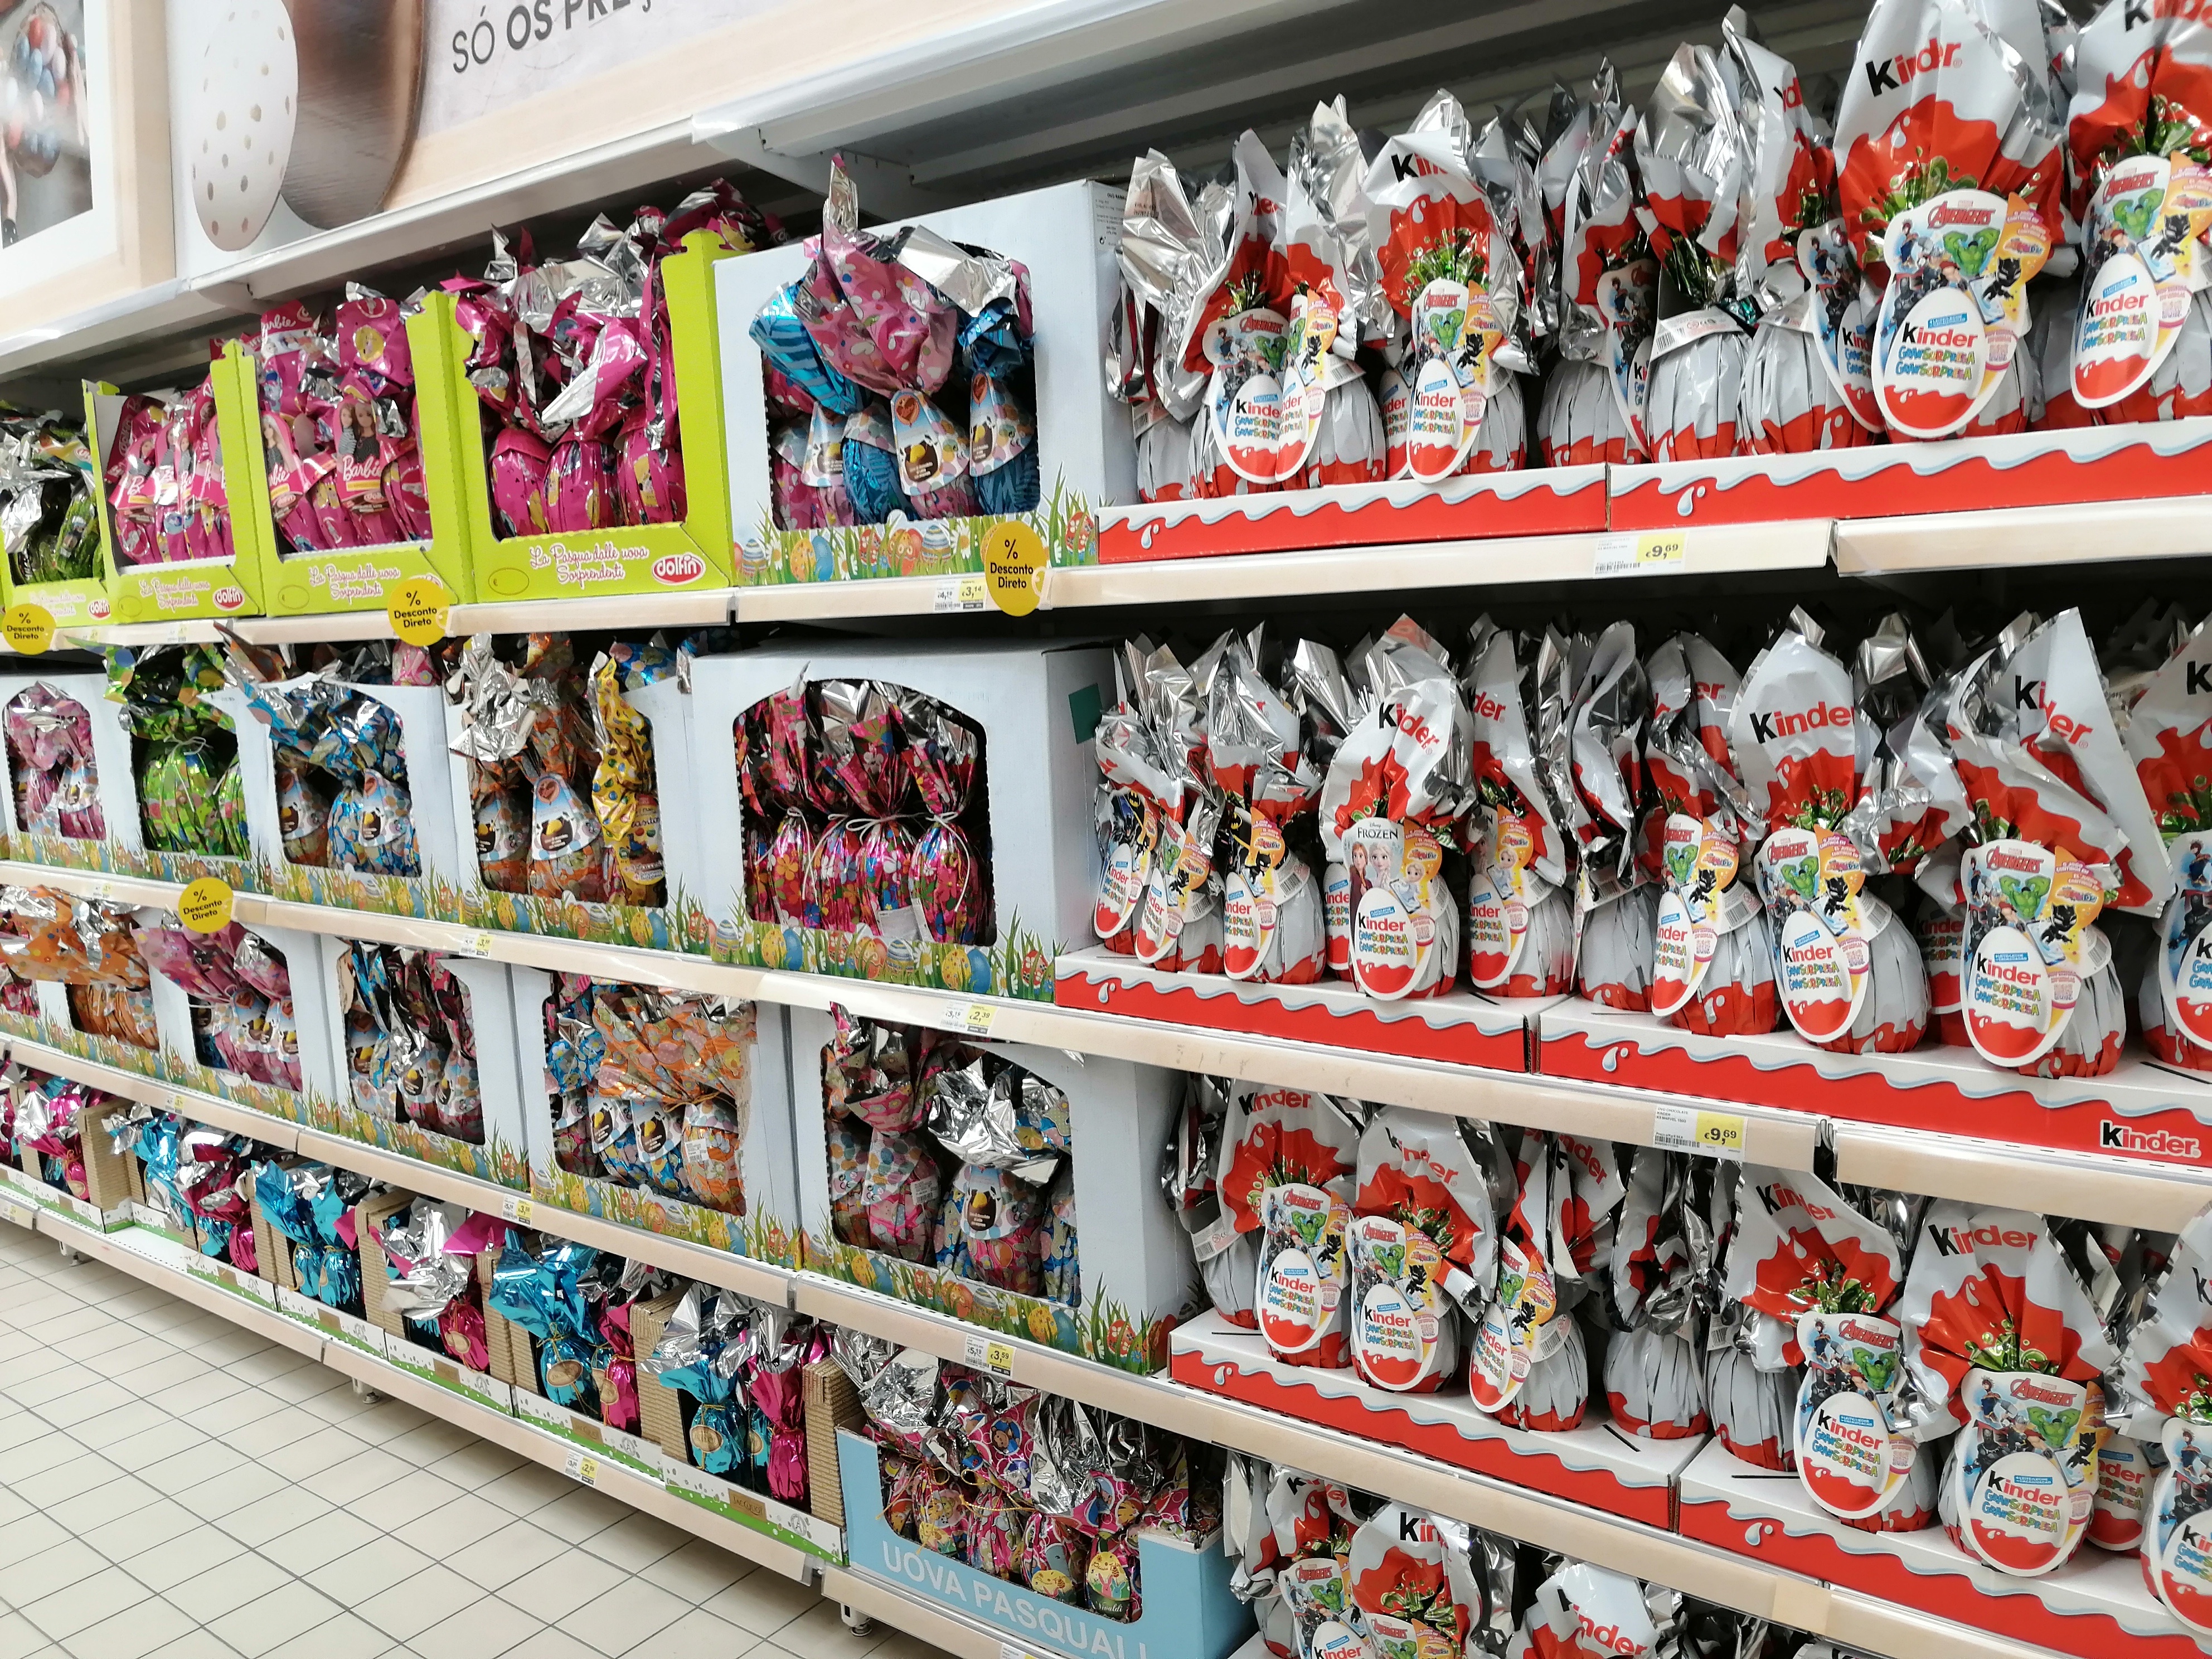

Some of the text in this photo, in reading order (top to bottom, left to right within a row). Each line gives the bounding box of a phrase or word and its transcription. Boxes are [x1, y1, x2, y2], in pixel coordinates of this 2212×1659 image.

[452, 0, 651, 74] SÓ OS PR
[1928, 200, 1995, 229] AVENGERS
[2087, 292, 2150, 319] Kinder
[1901, 322, 1978, 348] Kinder
[1236, 398, 1281, 419] Kinde
[1282, 394, 1303, 411] nder
[1415, 390, 1456, 408] Kinder
[530, 541, 649, 568] La Pasqua dalle uova
[657, 555, 698, 576] dolfin
[557, 562, 625, 589] Sorprendenti
[989, 562, 1034, 574] Desconto
[998, 577, 1027, 589] Direto
[394, 607, 437, 619] Desconto
[403, 617, 432, 628] Direto
[7, 625, 45, 633] Desconto
[13, 632, 39, 640] Direto
[1750, 701, 1855, 744] Kinde
[1357, 827, 1398, 840] FROZEN
[1767, 840, 1810, 866] AVENGERS
[1986, 846, 2044, 874] AVENGERS
[183, 899, 222, 915] Desconto
[192, 909, 218, 921] Direto
[1359, 912, 1406, 932] Kinder
[1657, 926, 1688, 942] inder
[1917, 917, 1963, 933] Kinde
[1784, 944, 1835, 963] Kinder
[1977, 952, 2041, 986] Kinder
[1704, 1127, 1737, 1145] €9,69
[2102, 1122, 2196, 1155] Kinder
[1559, 1134, 1609, 1185] nder
[1283, 1187, 1324, 1212] AVENGERS
[1362, 1221, 1398, 1244] AVENGERS
[1270, 1267, 1316, 1293] Kinder
[1364, 1304, 1410, 1328] Kinder
[990, 1350, 1010, 1364] €3,59
[2009, 1377, 2078, 1407] AVENGERS
[1817, 1409, 1884, 1451] Kinder
[2098, 1461, 2146, 1485] nder
[1987, 1469, 2063, 1507] Kinder
[1982, 1501, 2059, 1533] GRANSORPRESA
[1985, 1489, 2061, 1521] GRANSURPRESA
[1400, 1511, 1448, 1548] Kin
[882, 1540, 967, 1603] UOVA
